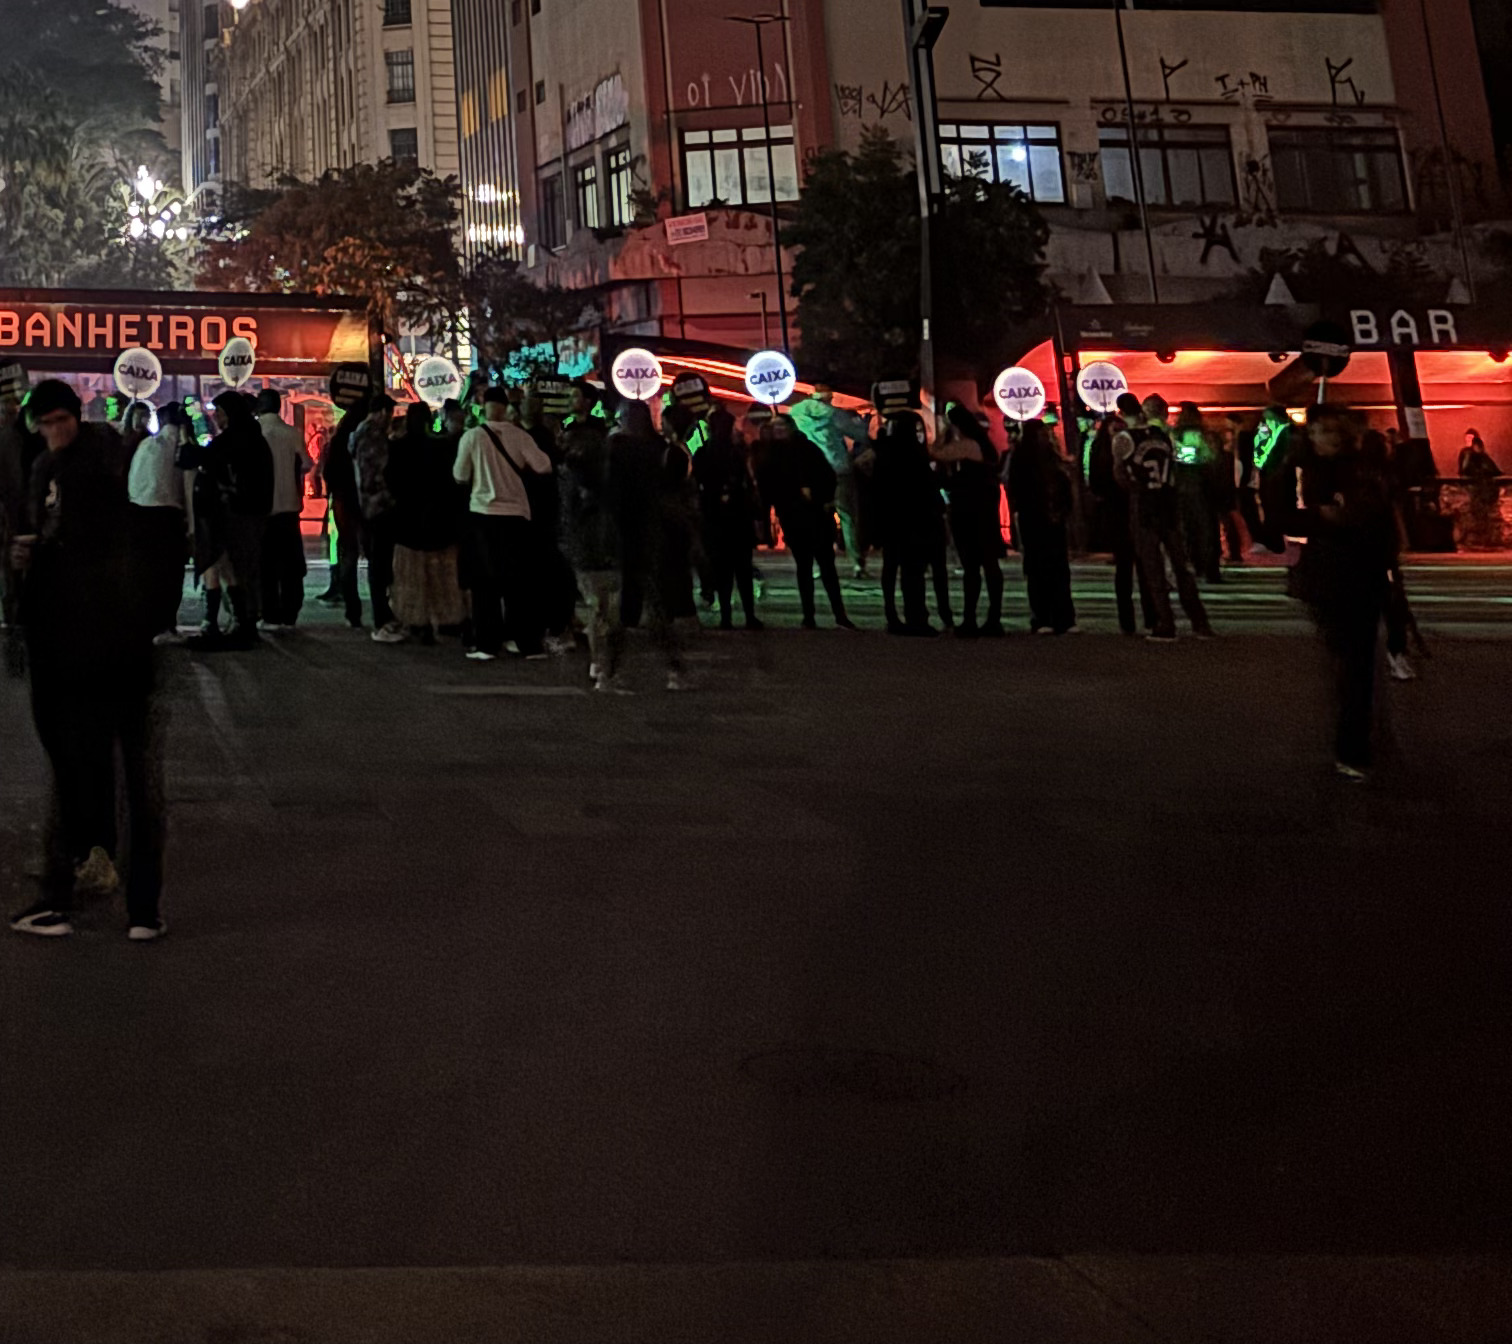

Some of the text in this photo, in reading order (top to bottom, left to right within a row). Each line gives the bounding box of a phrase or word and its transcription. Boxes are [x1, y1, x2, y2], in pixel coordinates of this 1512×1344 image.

[1350, 308, 1458, 345] BAR
[223, 354, 253, 367] CAIXA
[118, 363, 158, 382] CAIXA
[616, 367, 659, 379] CAIXA
[750, 369, 791, 385] CAIXA
[418, 373, 457, 388] CAIXA
[1082, 379, 1125, 390] CAIXA
[999, 387, 1042, 399] CAIXA
